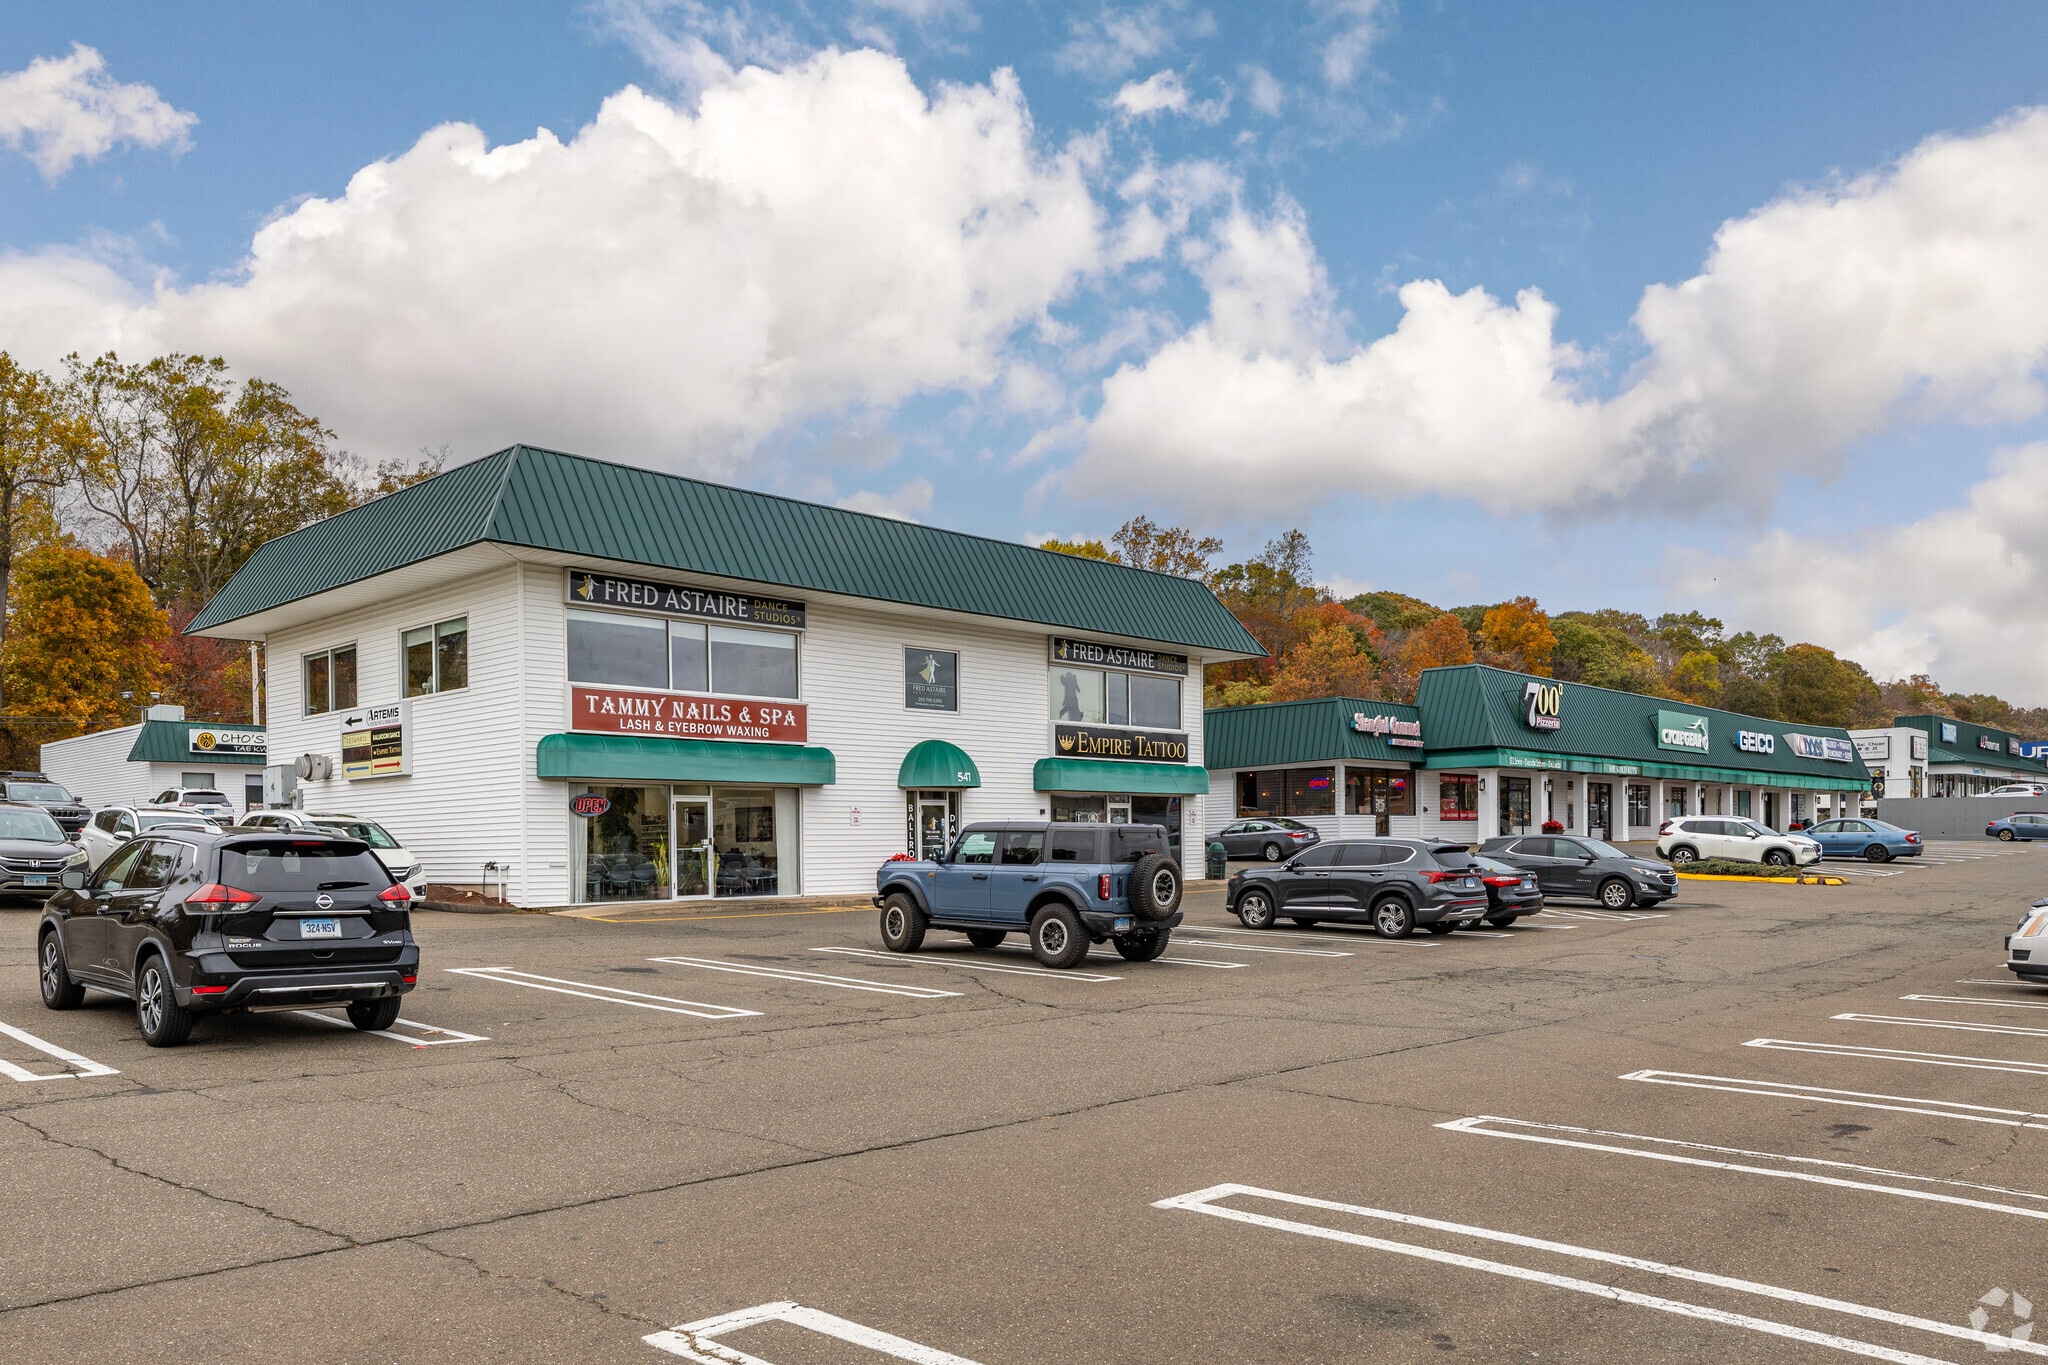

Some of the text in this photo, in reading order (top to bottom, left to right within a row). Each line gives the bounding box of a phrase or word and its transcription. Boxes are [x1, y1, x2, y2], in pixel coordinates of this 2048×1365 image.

[604, 579, 749, 618] FRED ASTAIRE
[754, 600, 788, 613] DANCE
[1073, 643, 1155, 669] FRED ASTAIRE
[1157, 654, 1178, 663] DANCE
[912, 684, 946, 694] FRED ASTAIRE
[368, 707, 399, 721] ARTEMIS
[585, 694, 797, 727] TAMMY NAILS & SPA
[619, 718, 769, 738] LASH & EYEBROW WAXING
[221, 733, 265, 744] CHO'S
[1077, 732, 1186, 759] EMPIRE TATTOO
[1737, 731, 1774, 754] GEICO
[1309, 779, 1329, 788] OPEN
[575, 797, 608, 813] OPEN
[907, 804, 915, 858] BALLRO
